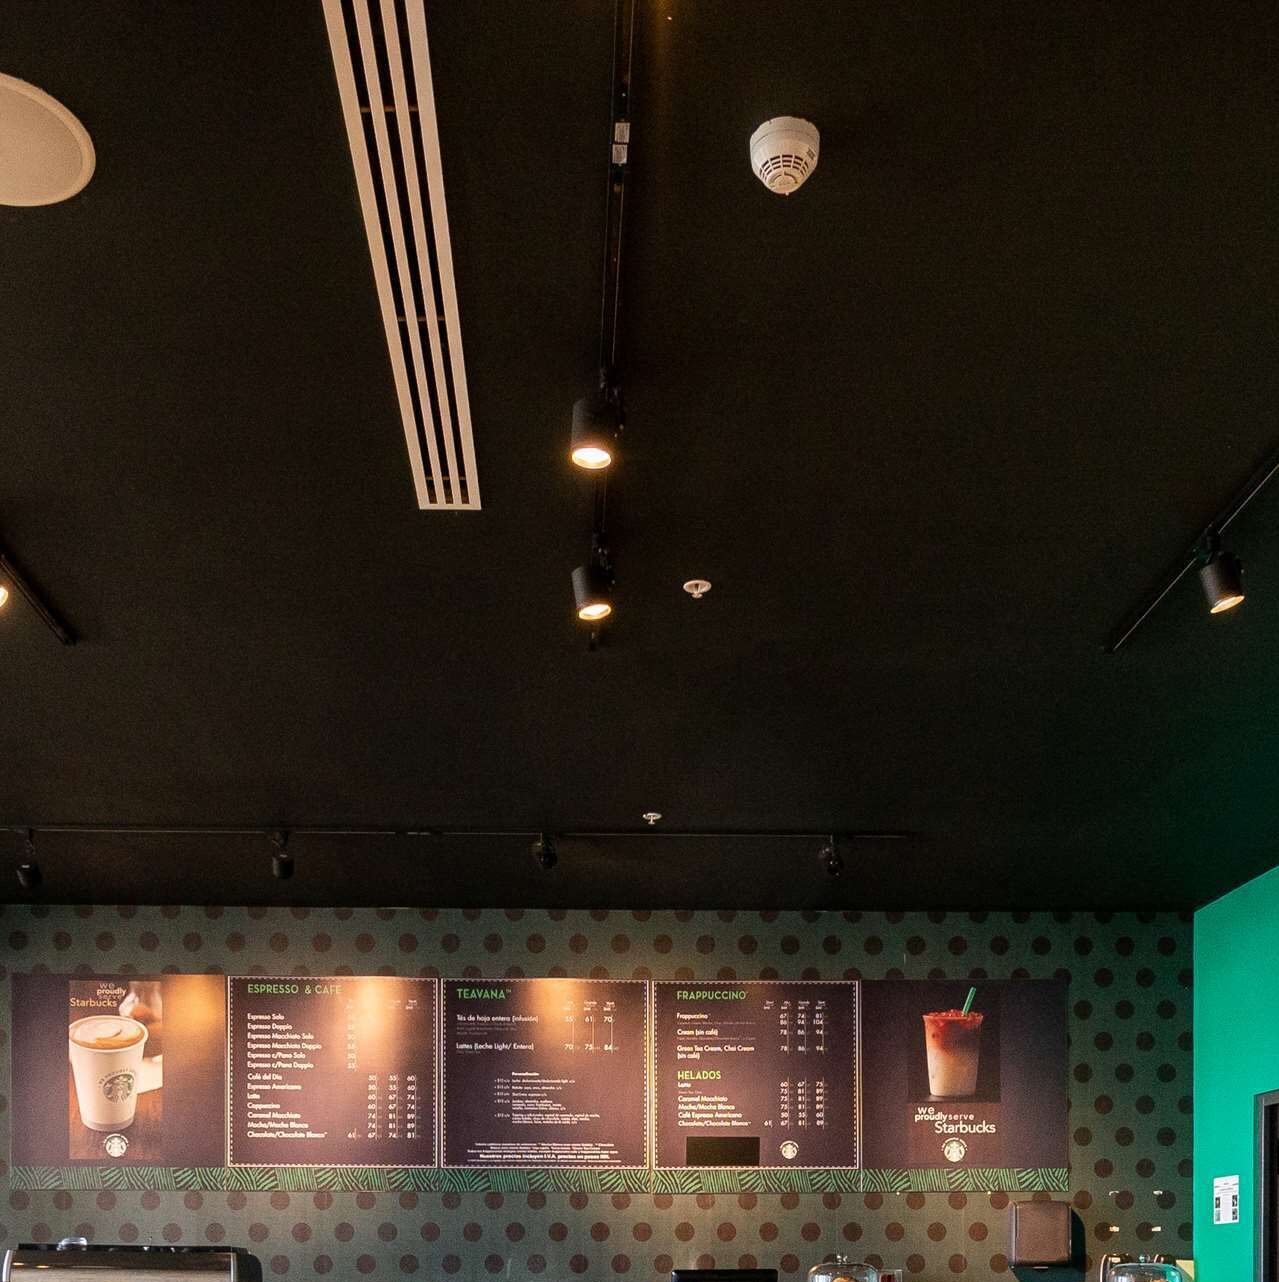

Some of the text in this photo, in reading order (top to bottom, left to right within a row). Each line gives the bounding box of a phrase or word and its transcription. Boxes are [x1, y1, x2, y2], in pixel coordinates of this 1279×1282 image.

[97, 987, 127, 997] proudly
[247, 984, 299, 994] ESPRESSO
[304, 985, 312, 994] &
[70, 997, 118, 1007] Starbucks
[247, 1013, 271, 1021] Espresso
[476, 1015, 490, 1023] hoja
[247, 1032, 271, 1040] Espresso
[301, 1032, 314, 1040] Solo
[247, 1061, 271, 1069] Espresso
[677, 1071, 721, 1080] HELADOS
[917, 1106, 935, 1114] we
[914, 1112, 948, 1123] proudly
[934, 1120, 996, 1133] Starbucks
